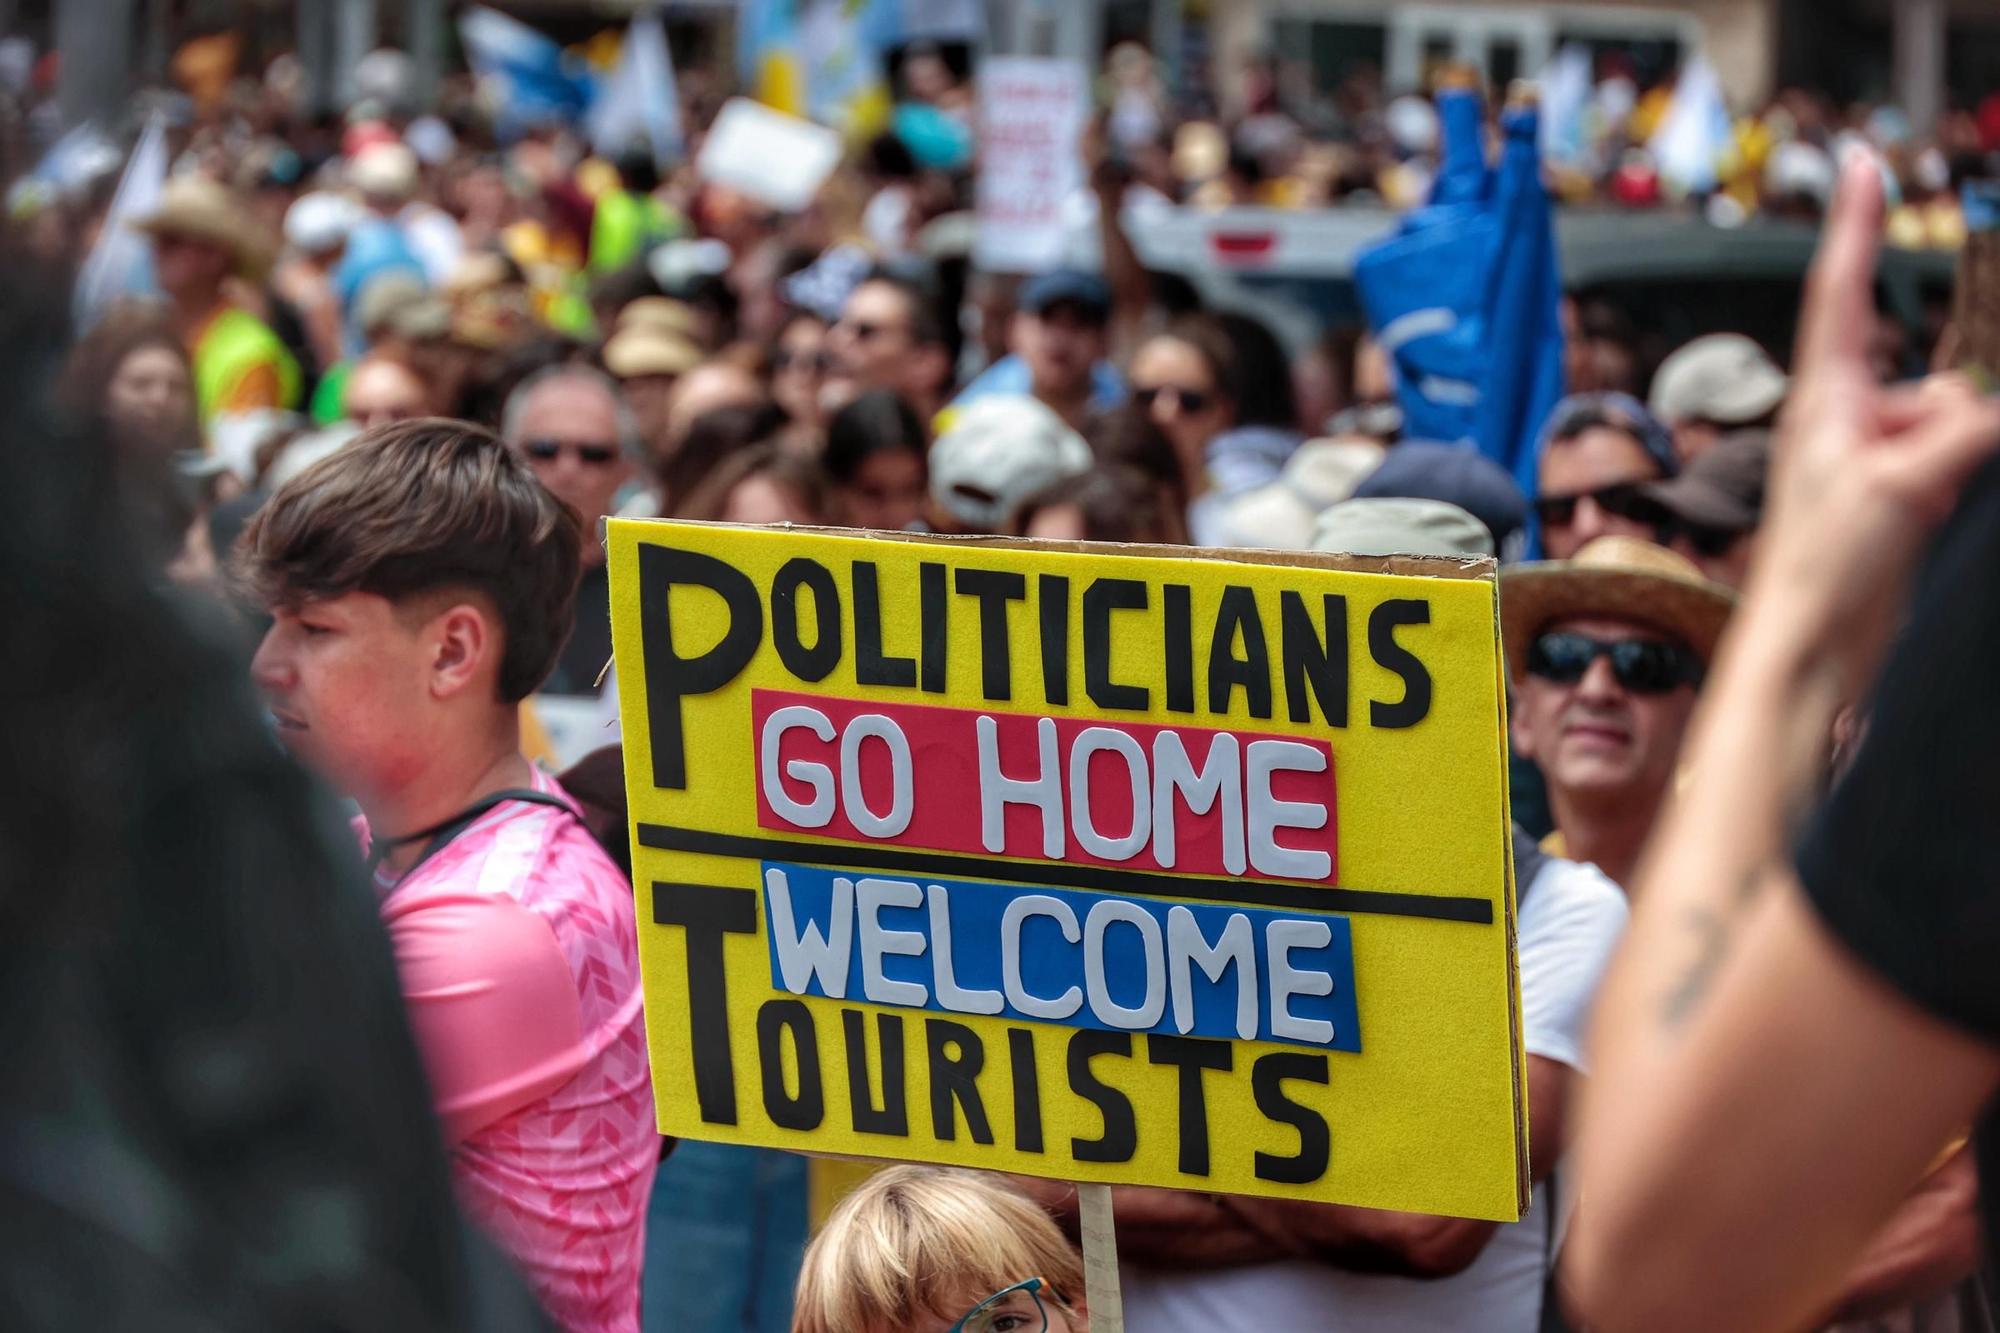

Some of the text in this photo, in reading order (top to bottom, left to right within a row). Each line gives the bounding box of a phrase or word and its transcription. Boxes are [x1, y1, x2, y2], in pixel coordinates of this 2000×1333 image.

[638, 542, 1431, 790] POLITICIANS
[761, 705, 1332, 880] GO HOME
[652, 882, 1330, 1184] TOURISTS
[764, 867, 1334, 1044] WELCOME
